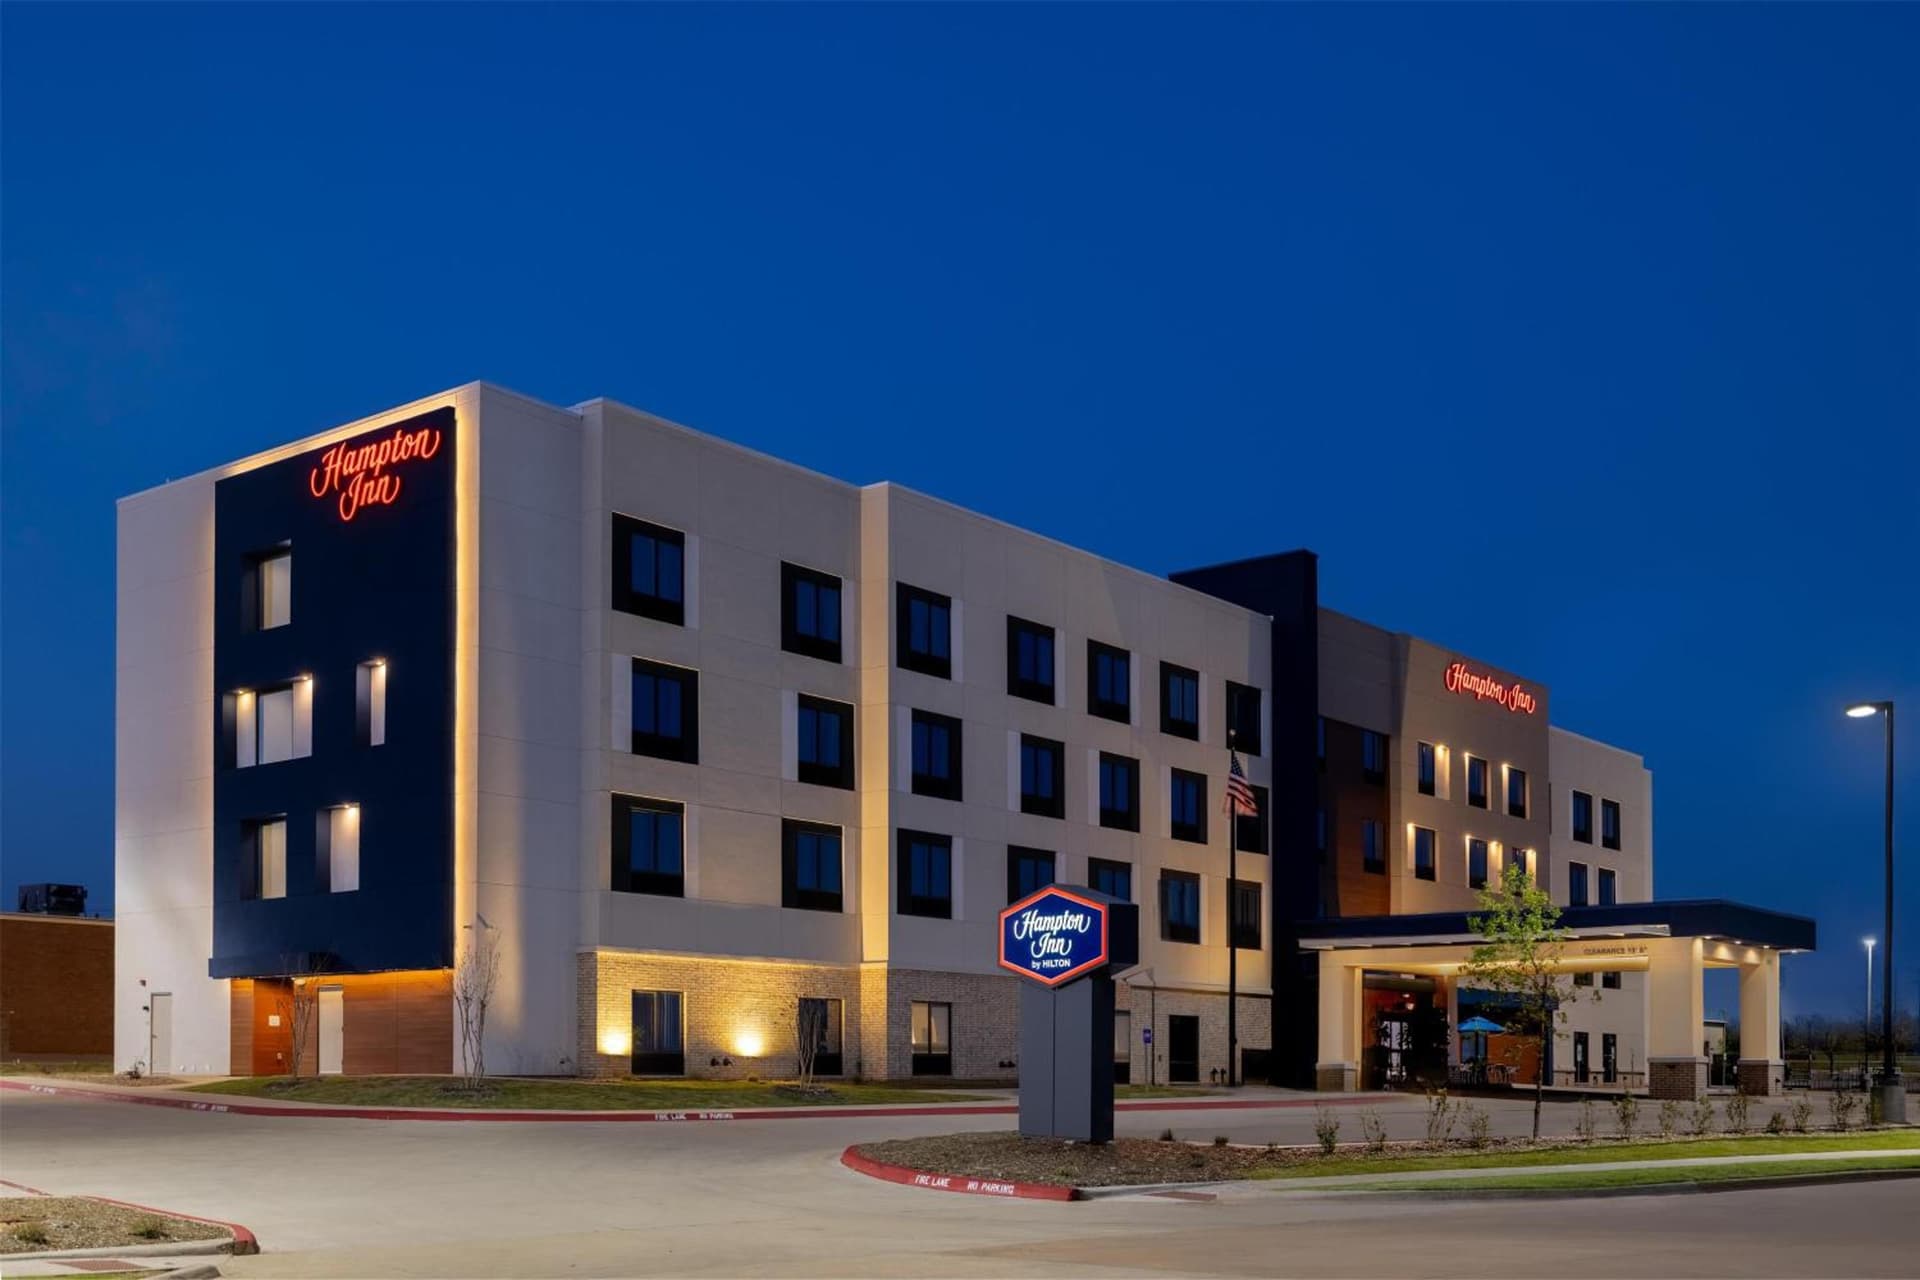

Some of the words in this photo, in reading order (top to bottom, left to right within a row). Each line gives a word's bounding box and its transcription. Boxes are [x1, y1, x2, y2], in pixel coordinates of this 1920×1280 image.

[311, 429, 440, 497] Hampton
[339, 471, 400, 521] Inn
[1446, 663, 1508, 705] Hampton
[1508, 684, 1536, 714] Inn
[1013, 909, 1091, 940] Hampton
[1030, 932, 1072, 959] Inn
[1031, 960, 1041, 969] by
[1042, 959, 1071, 968] HILTON
[915, 1174, 930, 1185] FIRE
[931, 1178, 951, 1187] LANE
[967, 1180, 979, 1191] NO
[981, 1182, 1015, 1194] PARKING
